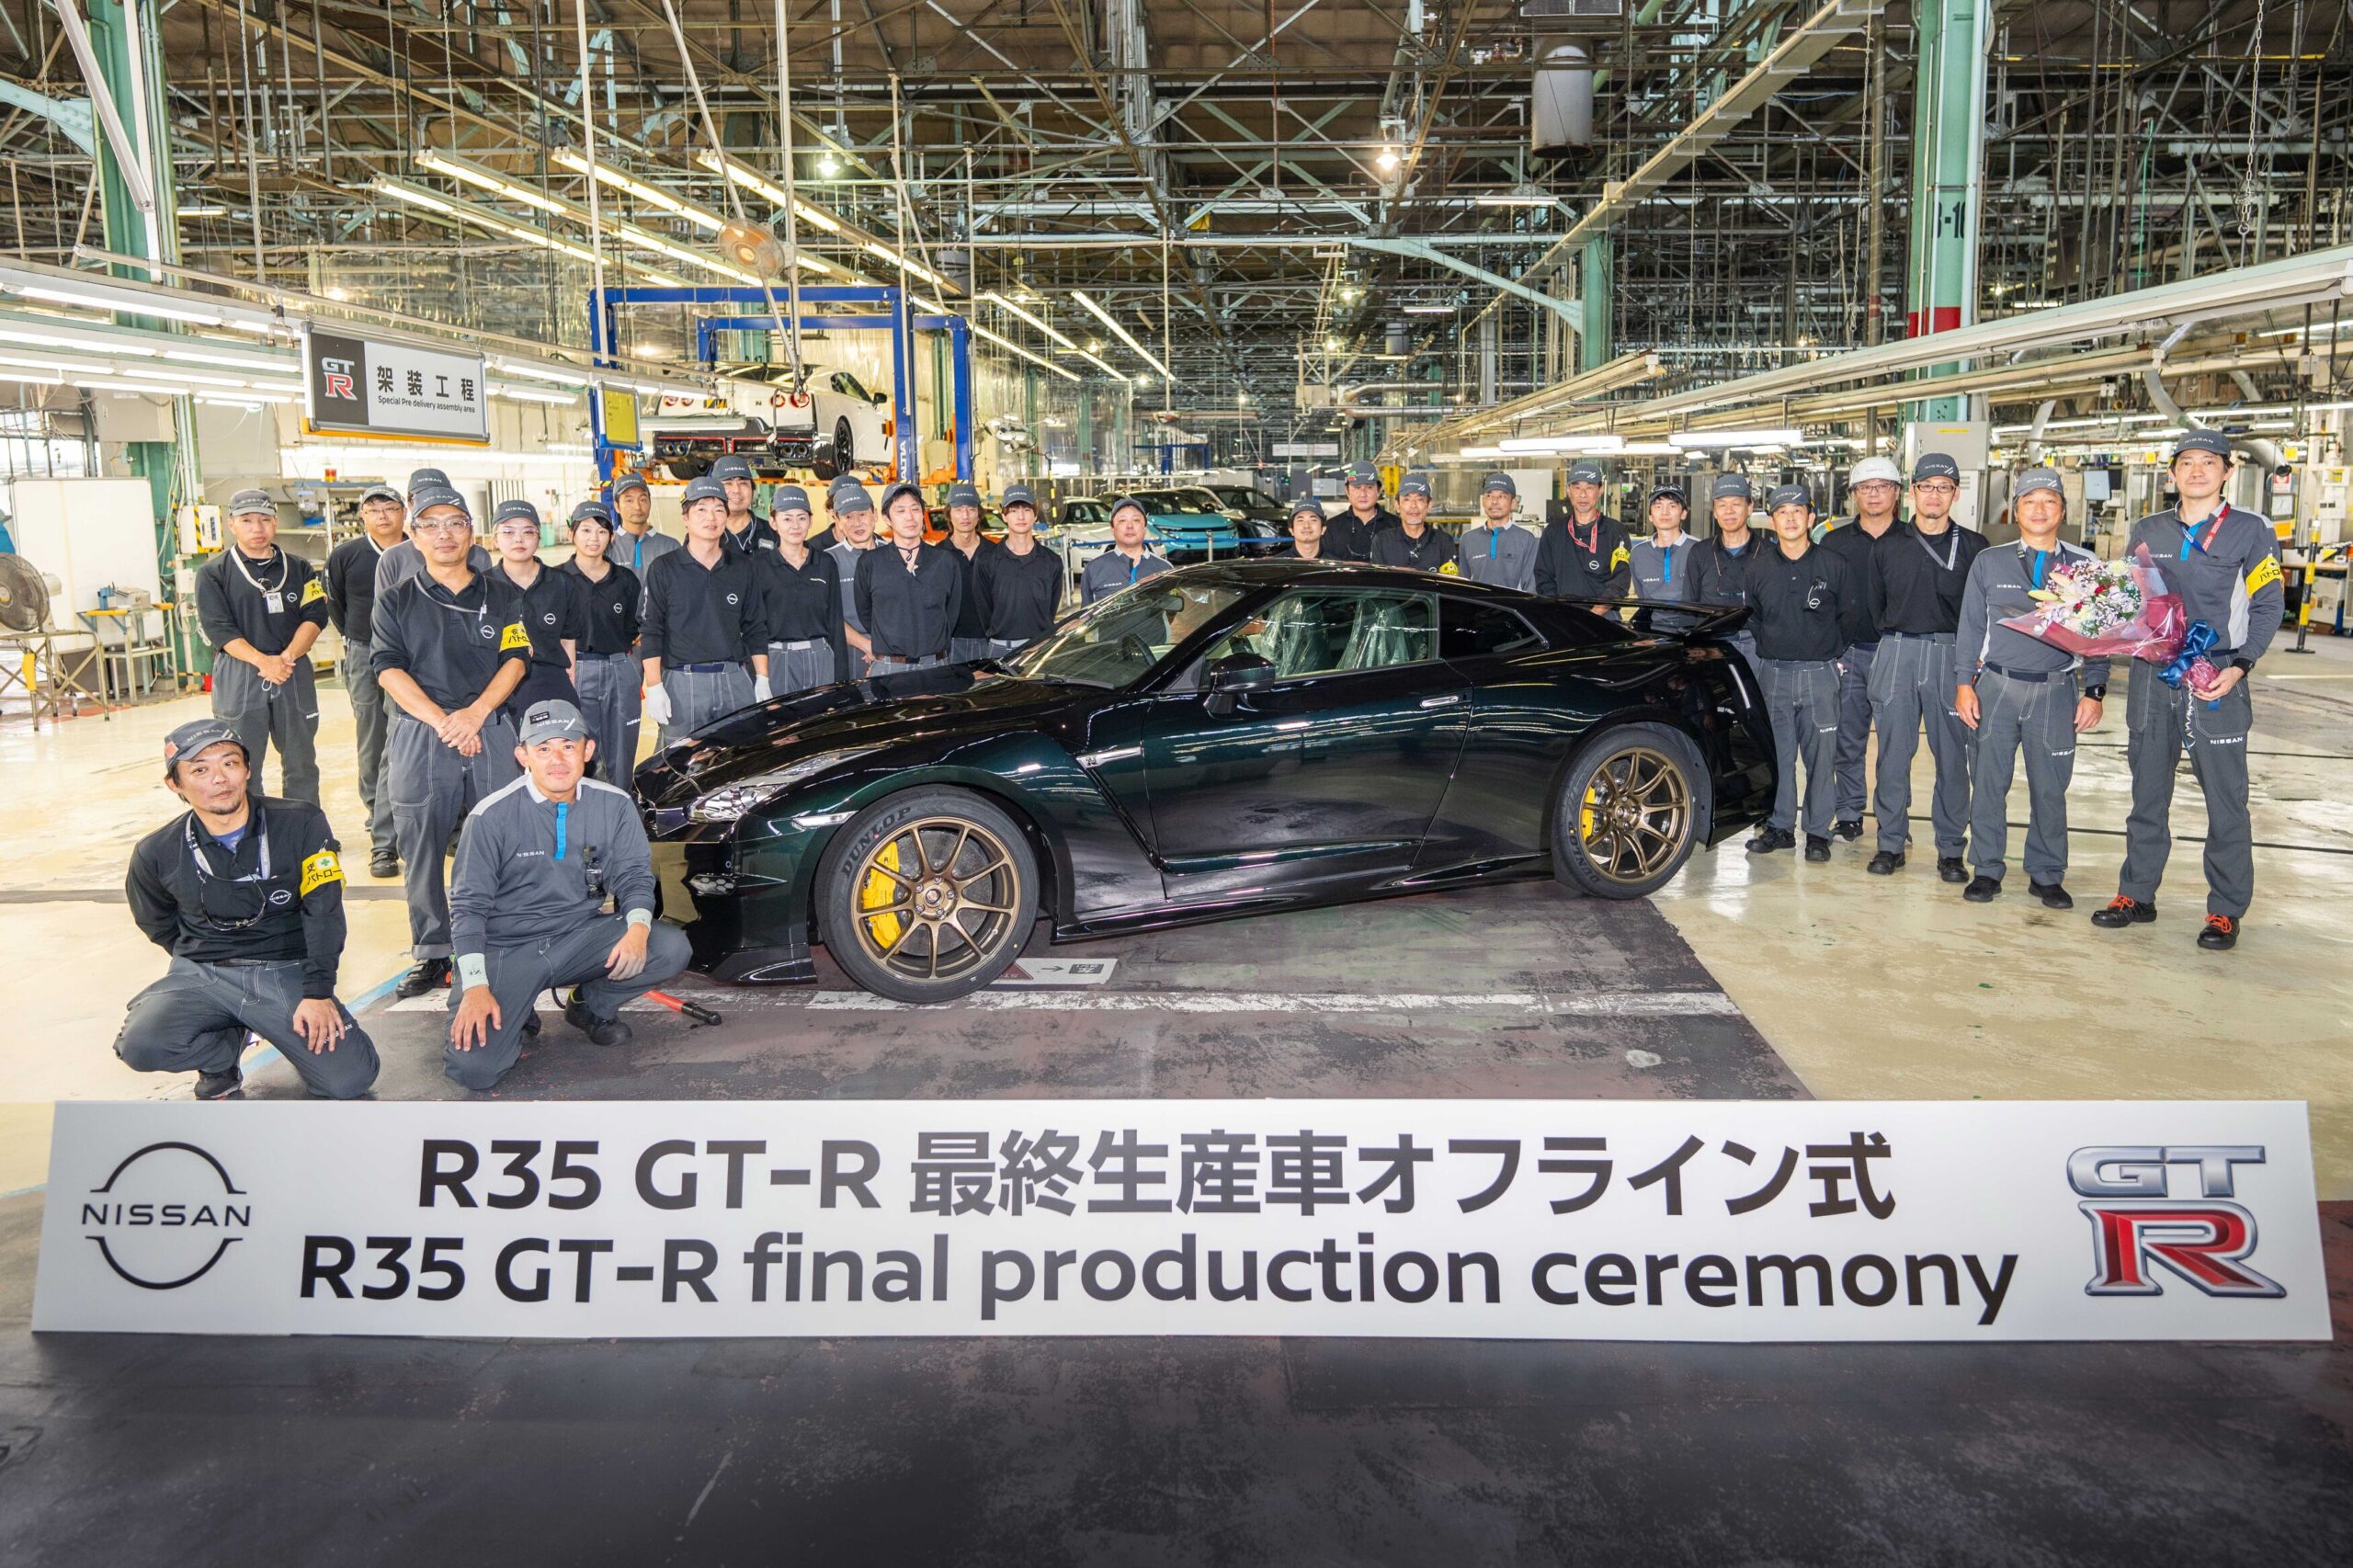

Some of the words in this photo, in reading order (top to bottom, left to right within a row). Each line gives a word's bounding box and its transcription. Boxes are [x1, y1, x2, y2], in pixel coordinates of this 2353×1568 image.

[322, 357, 355, 374] GT
[377, 365, 474, 402] 架装工程
[324, 371, 358, 402] R
[378, 395, 401, 405] Special
[402, 398, 412, 406] Pre
[413, 398, 436, 411] delivery
[437, 402, 462, 414] assembly
[463, 405, 475, 414] area
[537, 719, 570, 727] NISSAN
[841, 806, 911, 879] DUNLOP
[419, 1139, 601, 1210] R35
[636, 1140, 880, 1210] GT-R
[911, 1130, 1895, 1220] 最終生産車オフライン式
[2066, 1145, 2266, 1198] GT
[82, 1203, 252, 1228] NISSAN
[2078, 1200, 2287, 1298] R
[301, 1235, 466, 1301] R35
[495, 1237, 719, 1303] GT-R
[744, 1232, 949, 1302] final
[982, 1232, 1500, 1321] production
[1532, 1253, 2018, 1325] ceremony
